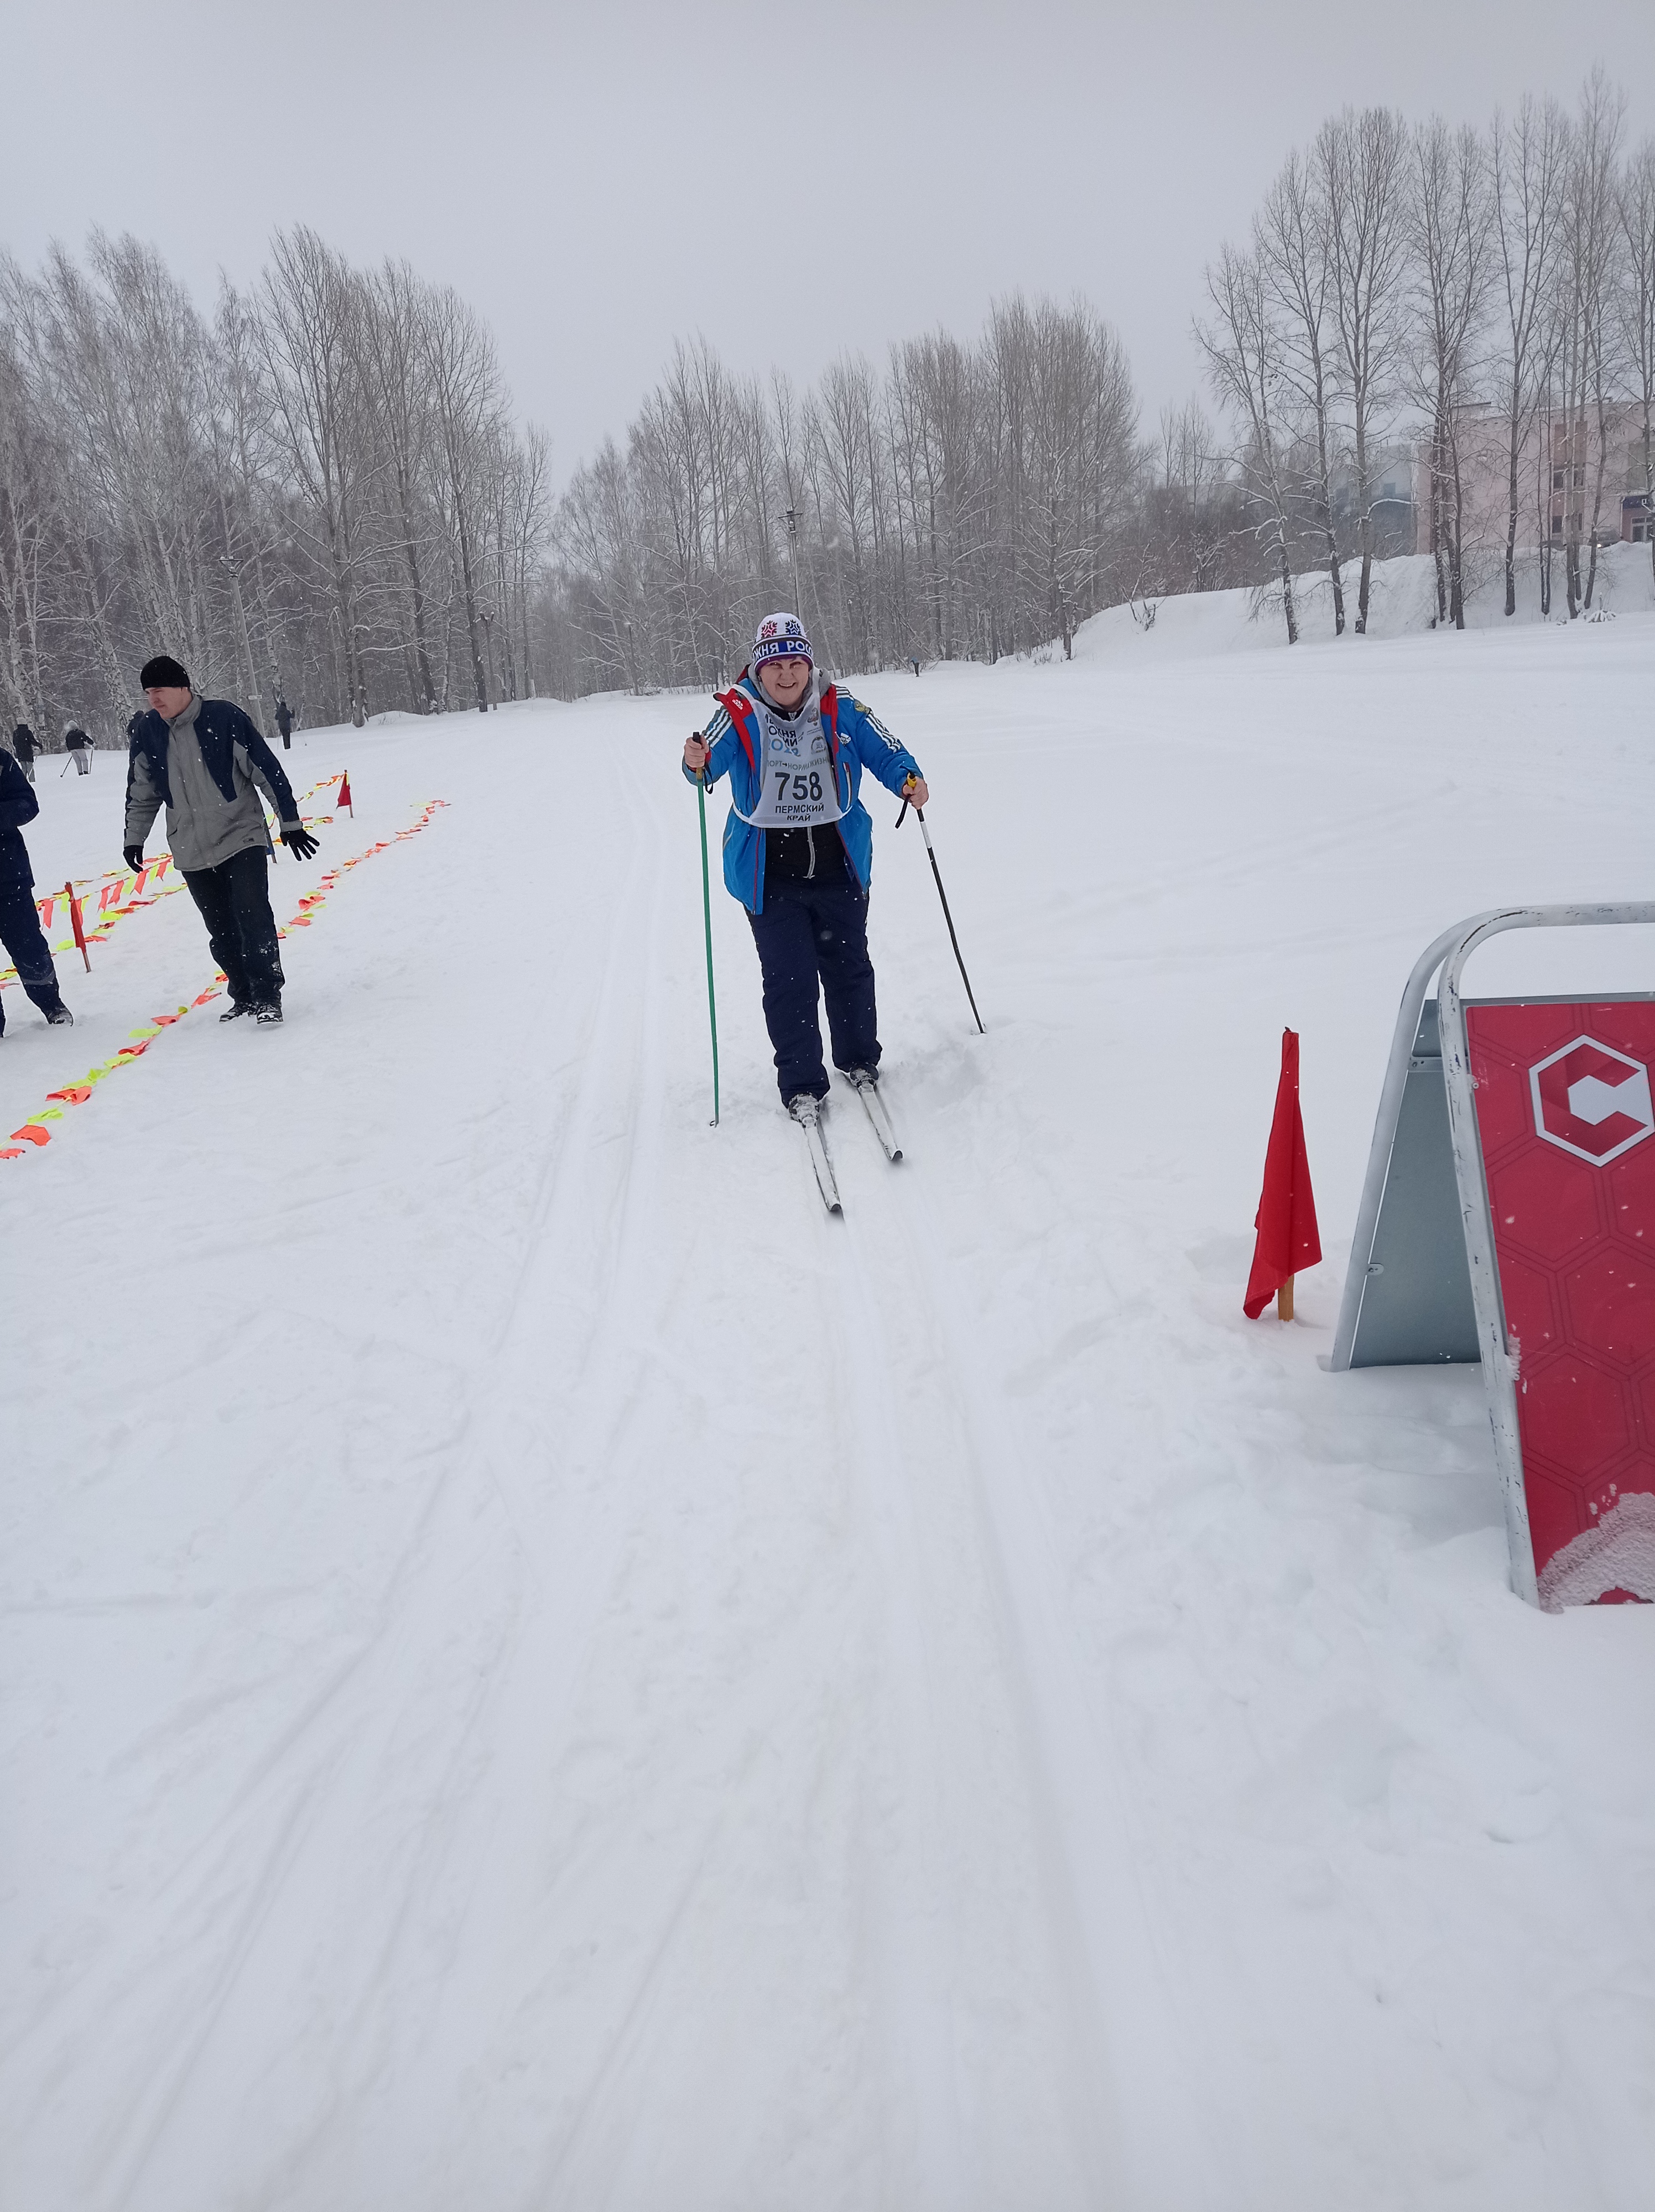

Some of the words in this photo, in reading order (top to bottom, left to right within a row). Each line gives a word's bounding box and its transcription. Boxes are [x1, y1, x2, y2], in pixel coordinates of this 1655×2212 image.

[768, 738, 802, 757] 022
[775, 771, 823, 801] 758
[775, 802, 824, 813] ПЕРМСКИЙ
[787, 813, 811, 821] КРАЙ
